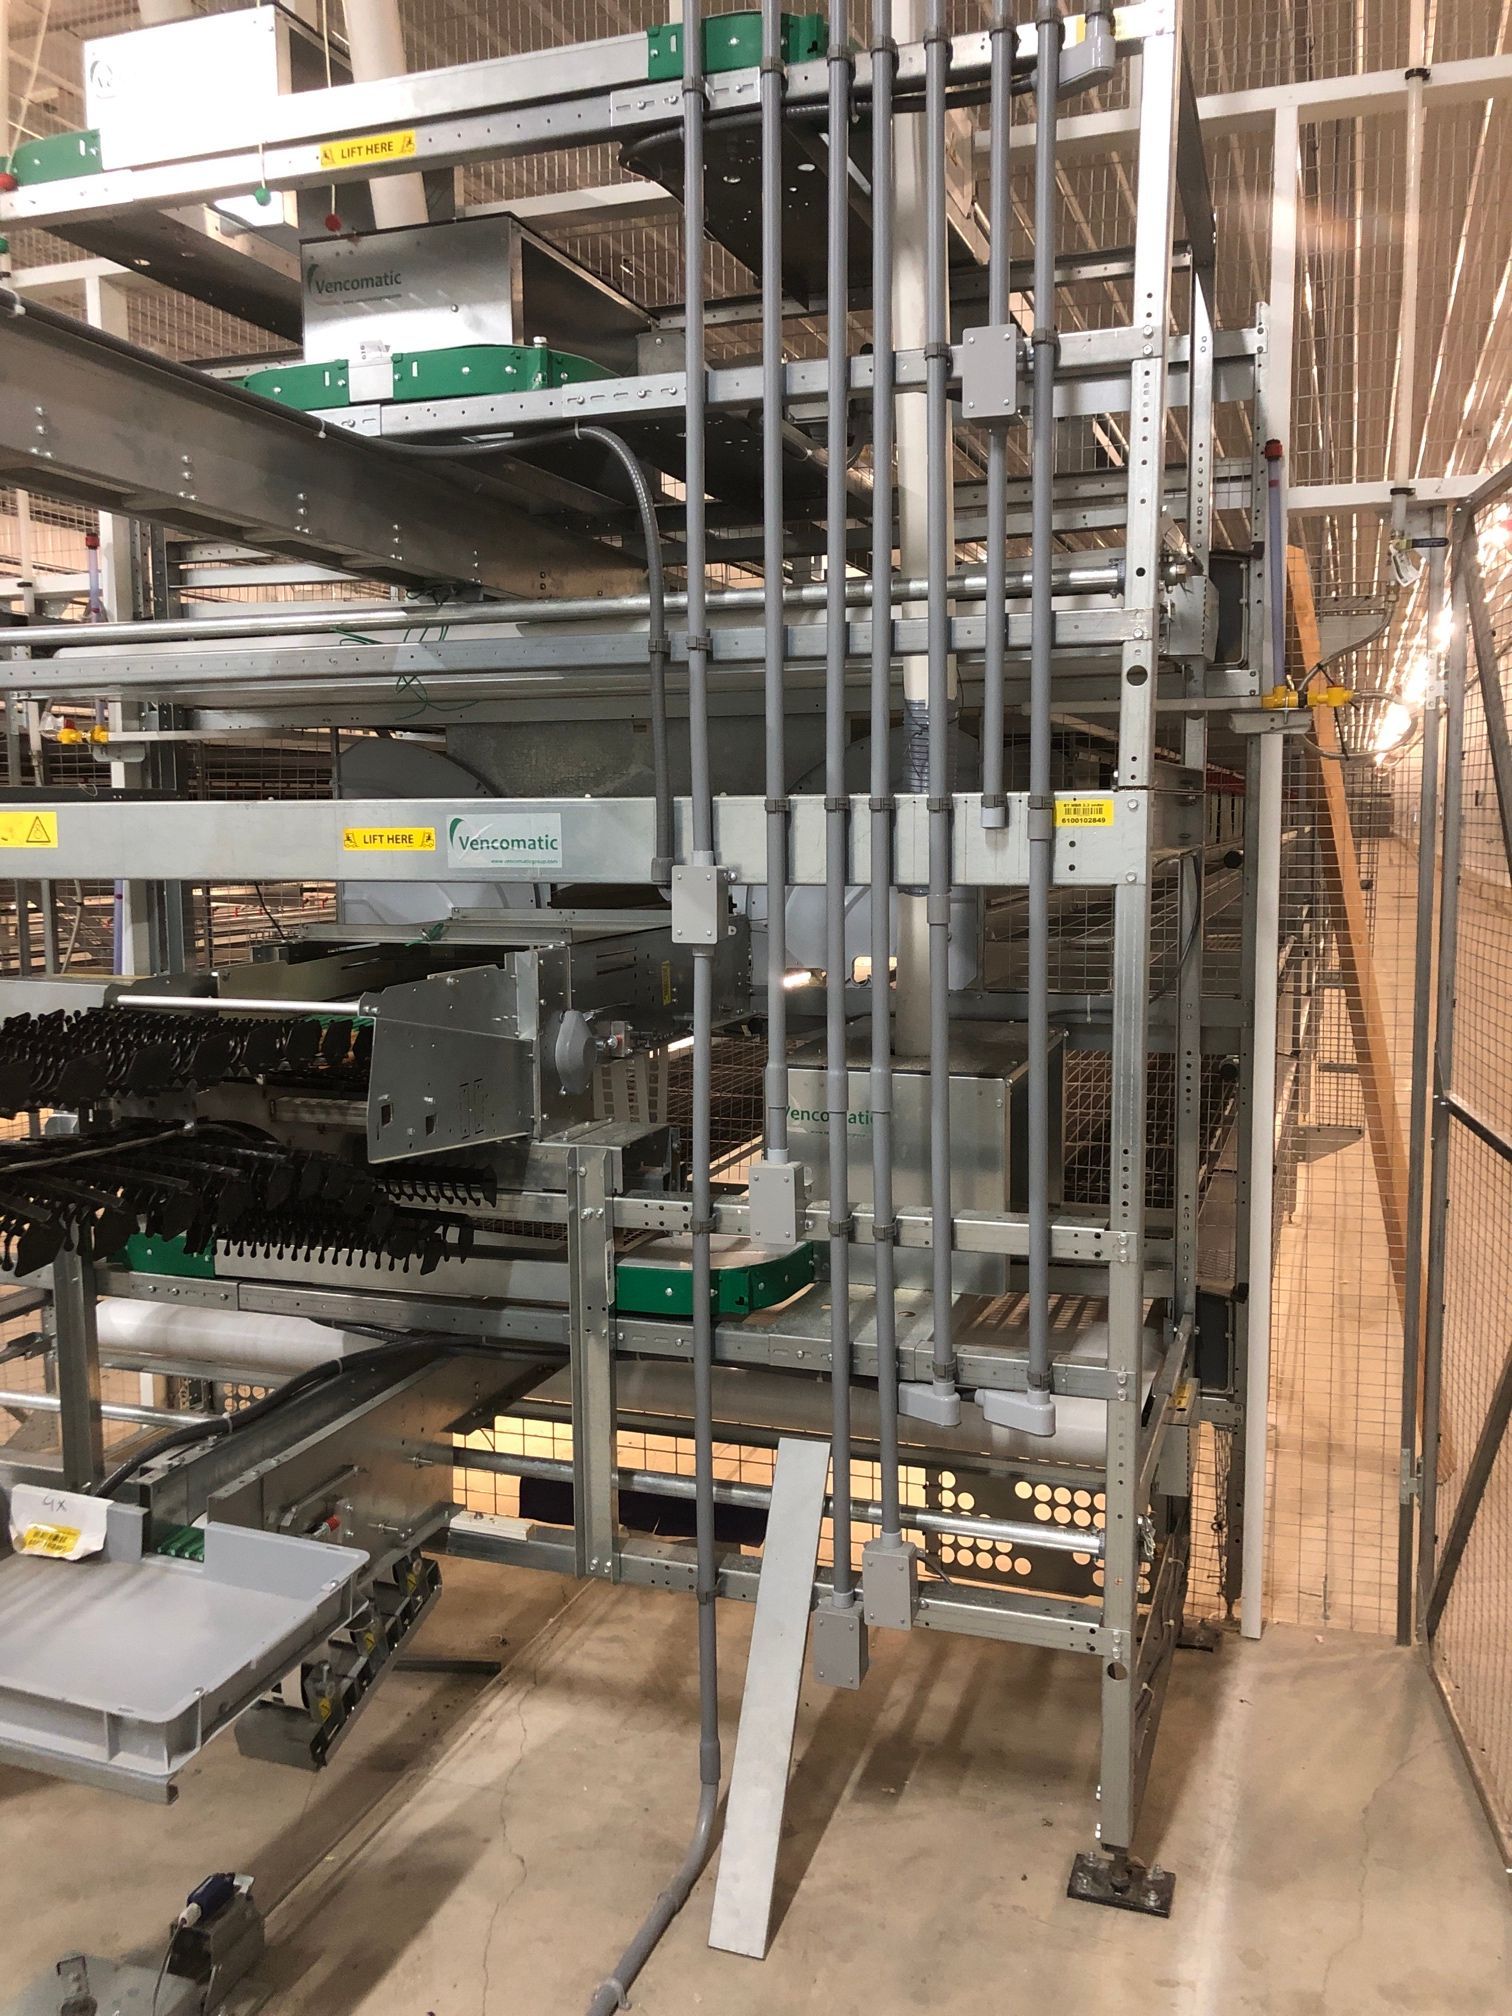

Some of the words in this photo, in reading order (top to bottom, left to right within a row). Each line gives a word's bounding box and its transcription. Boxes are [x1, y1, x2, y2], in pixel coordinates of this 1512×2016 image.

[341, 146, 363, 159] LIFT
[365, 141, 394, 155] HERE
[315, 269, 402, 294] Vencomatic
[363, 834, 384, 844] LIFT
[387, 834, 414, 844] HERE
[458, 834, 558, 851] Vencomatic
